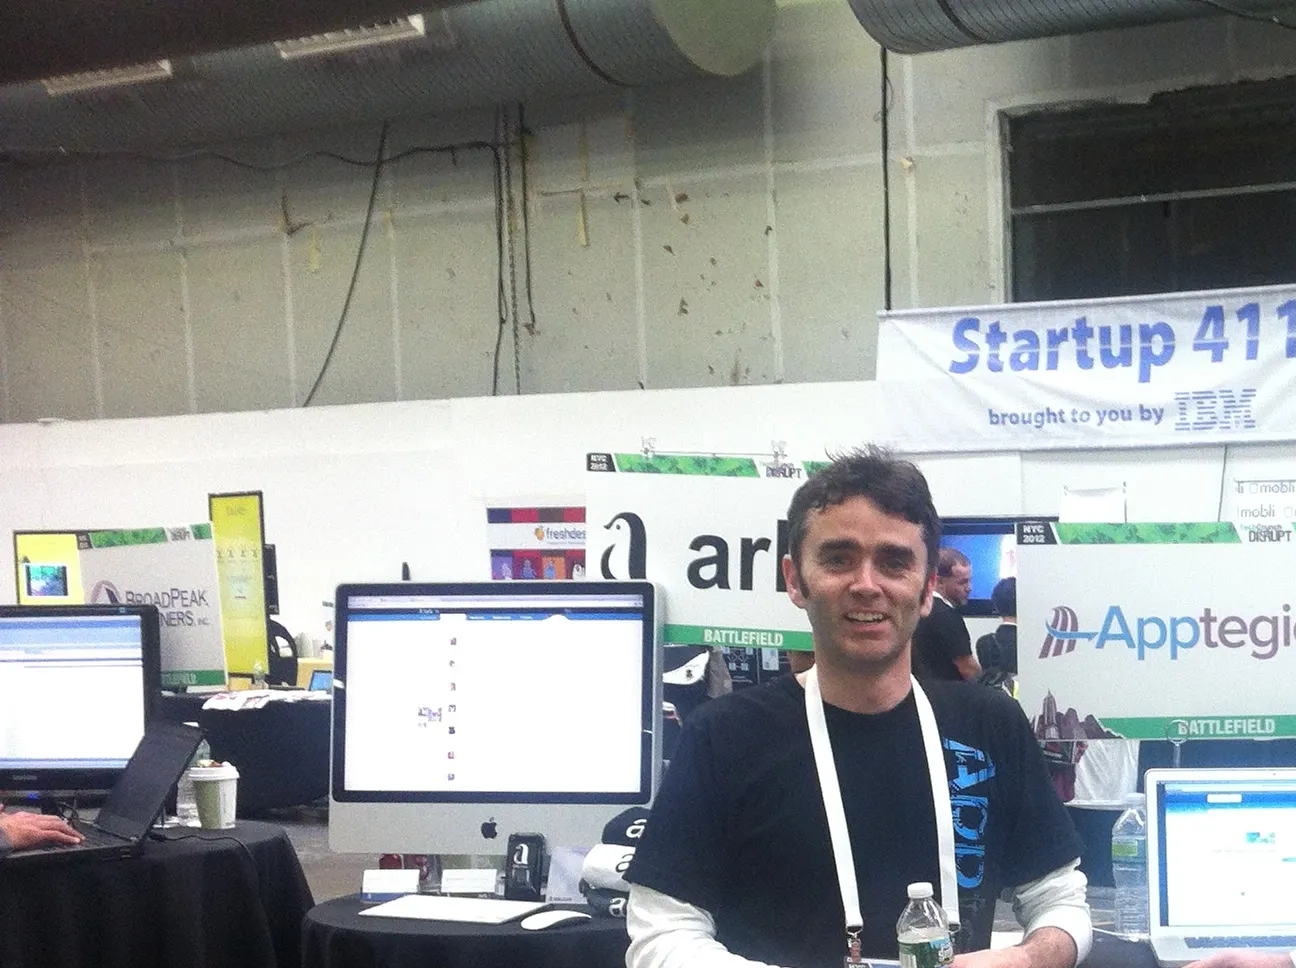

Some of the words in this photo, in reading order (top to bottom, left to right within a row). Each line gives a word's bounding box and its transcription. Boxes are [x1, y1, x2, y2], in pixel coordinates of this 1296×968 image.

[949, 314, 1176, 384] Startup
[989, 406, 1065, 429] brought
[1069, 408, 1091, 424] to
[1096, 407, 1132, 427] you
[1139, 405, 1164, 425] by
[1174, 388, 1257, 431] IBM
[1259, 481, 1295, 494] mobli
[1240, 504, 1275, 518] mobli
[1023, 524, 1044, 533] NYC
[1023, 534, 1045, 543] 2012
[1249, 530, 1292, 543] DISRUPT
[704, 629, 783, 646] BATTLEFIELD
[1177, 717, 1276, 737] BATTLEFIELD
